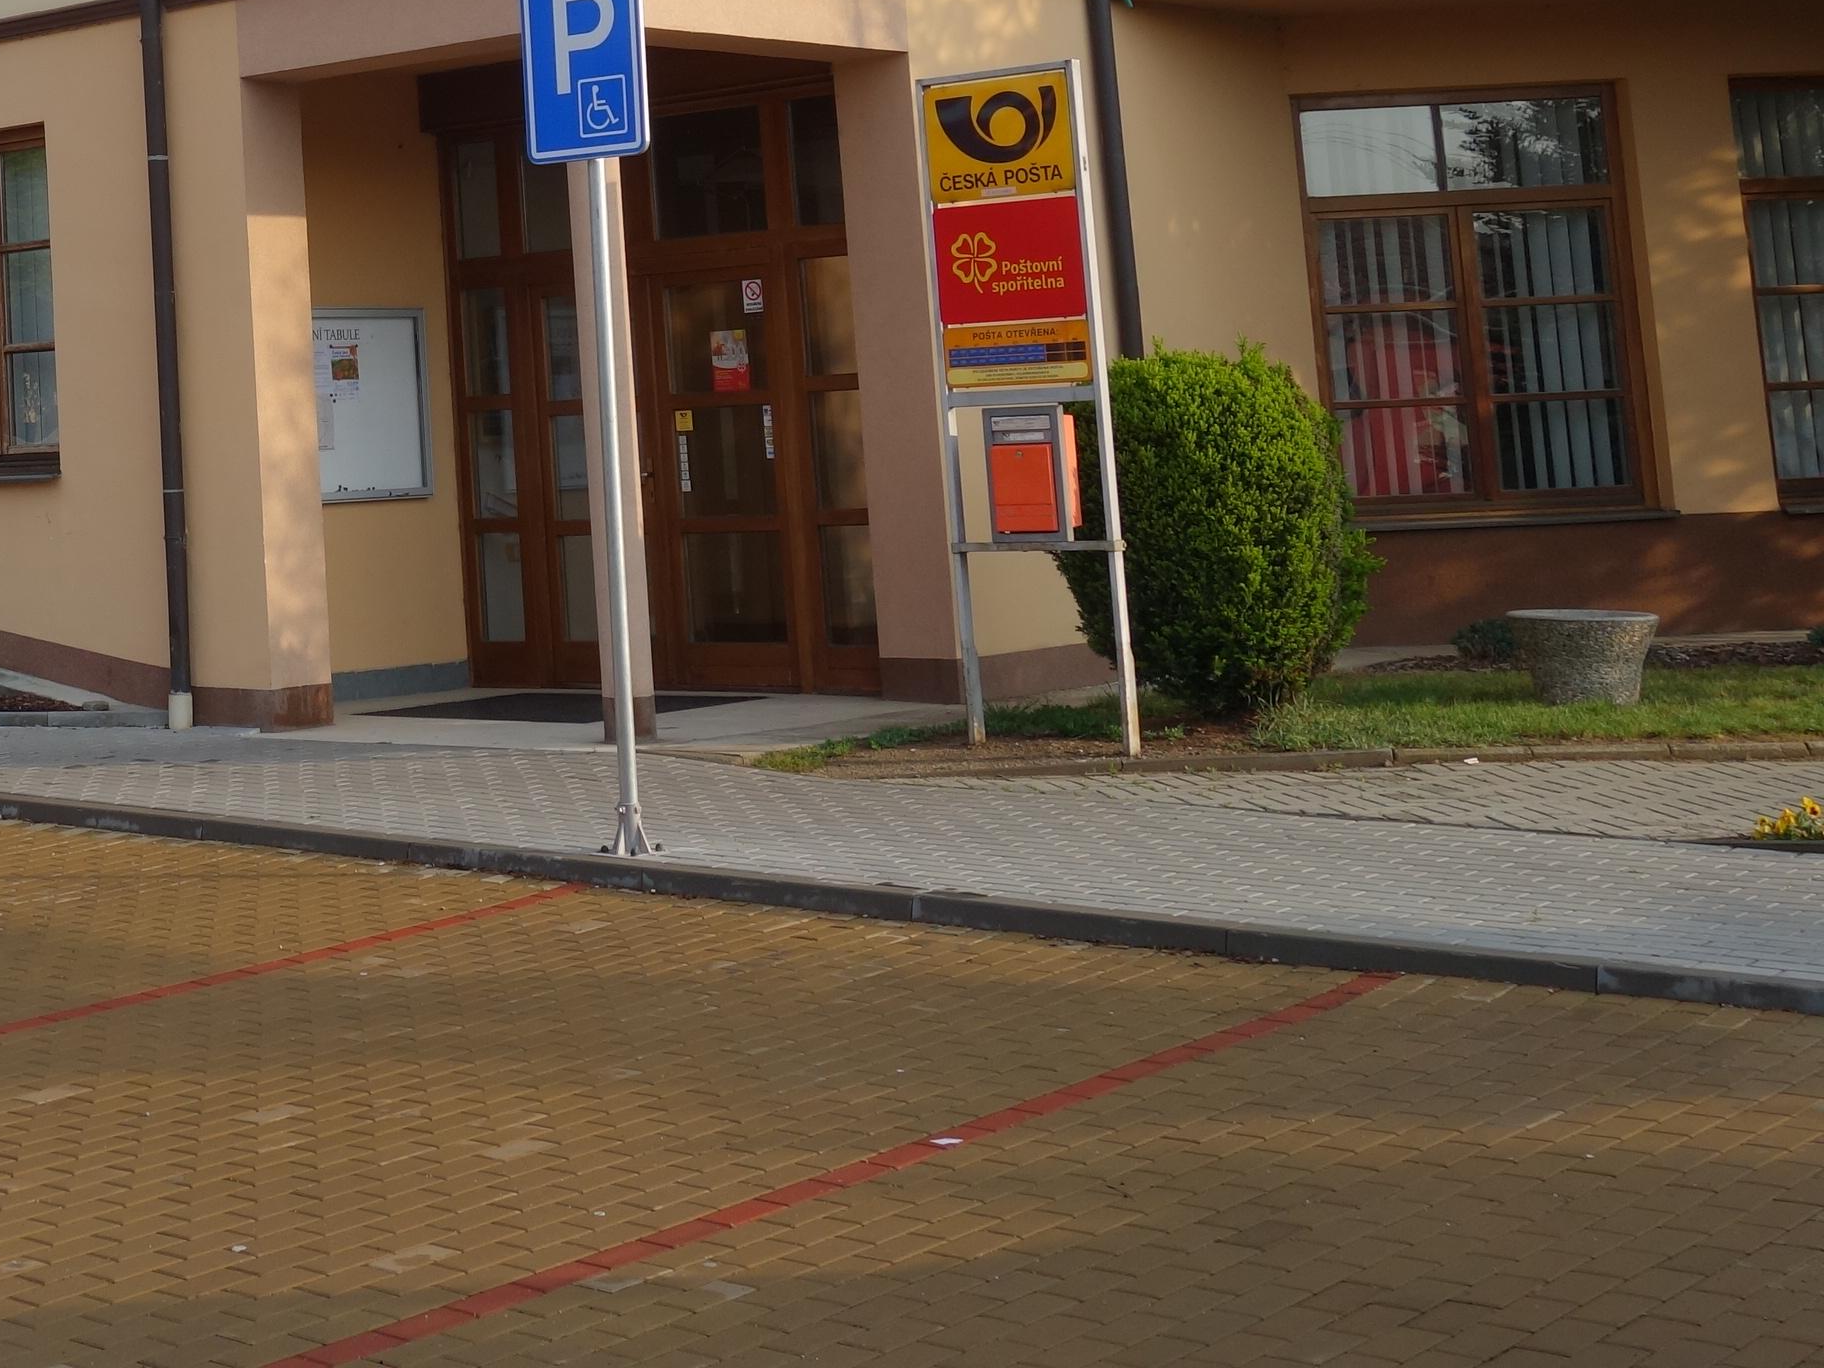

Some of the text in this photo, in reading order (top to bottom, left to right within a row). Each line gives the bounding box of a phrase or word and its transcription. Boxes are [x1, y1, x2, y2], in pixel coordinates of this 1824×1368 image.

[939, 167, 997, 192] ČESKÁ
[1004, 163, 1063, 185] POŠTA
[1001, 256, 1063, 275] Poštovní
[992, 274, 1065, 296] spořitelna
[325, 328, 360, 341] TABULE
[972, 327, 1057, 341] POŠTA OTEVŘENA
